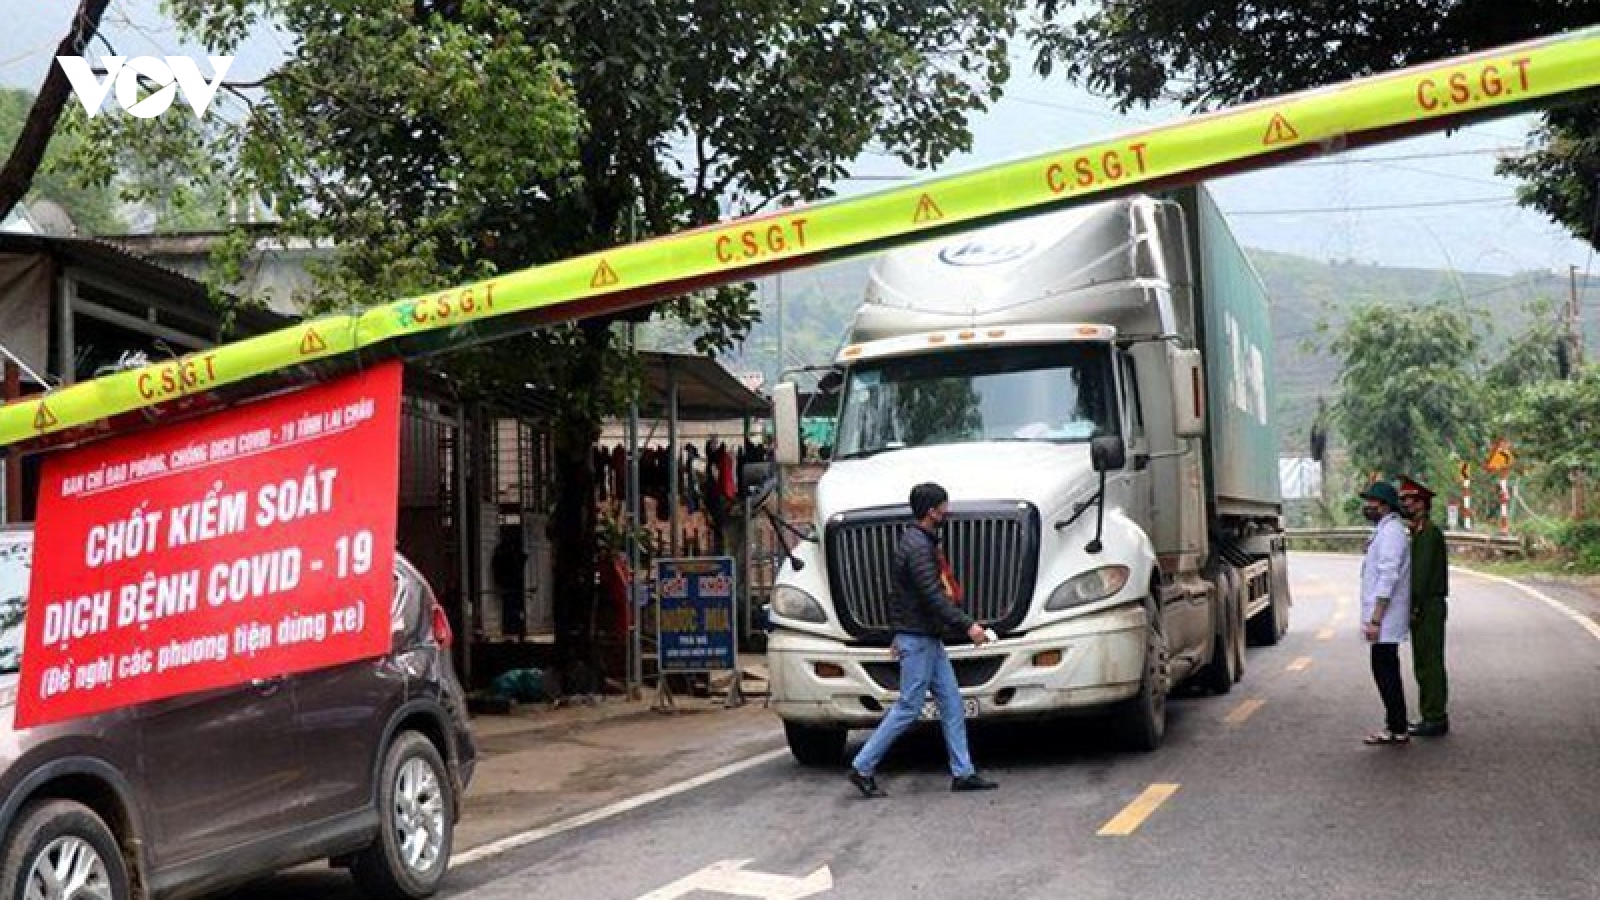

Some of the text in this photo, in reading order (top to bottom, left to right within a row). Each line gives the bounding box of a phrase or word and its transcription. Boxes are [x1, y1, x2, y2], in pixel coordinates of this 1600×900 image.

[1417, 58, 1531, 110] C.S.G.T
[1046, 143, 1147, 194] C.S.G.T
[715, 219, 807, 262] C.S.G.T
[86, 464, 337, 567] CHỐT KIỂM SOÁT
[42, 530, 373, 650] DỊCH BỆNH COVID - 19
[74, 652, 115, 689] nghị
[118, 648, 152, 678] các
[233, 621, 272, 658] tiện
[332, 600, 365, 634] xe)
